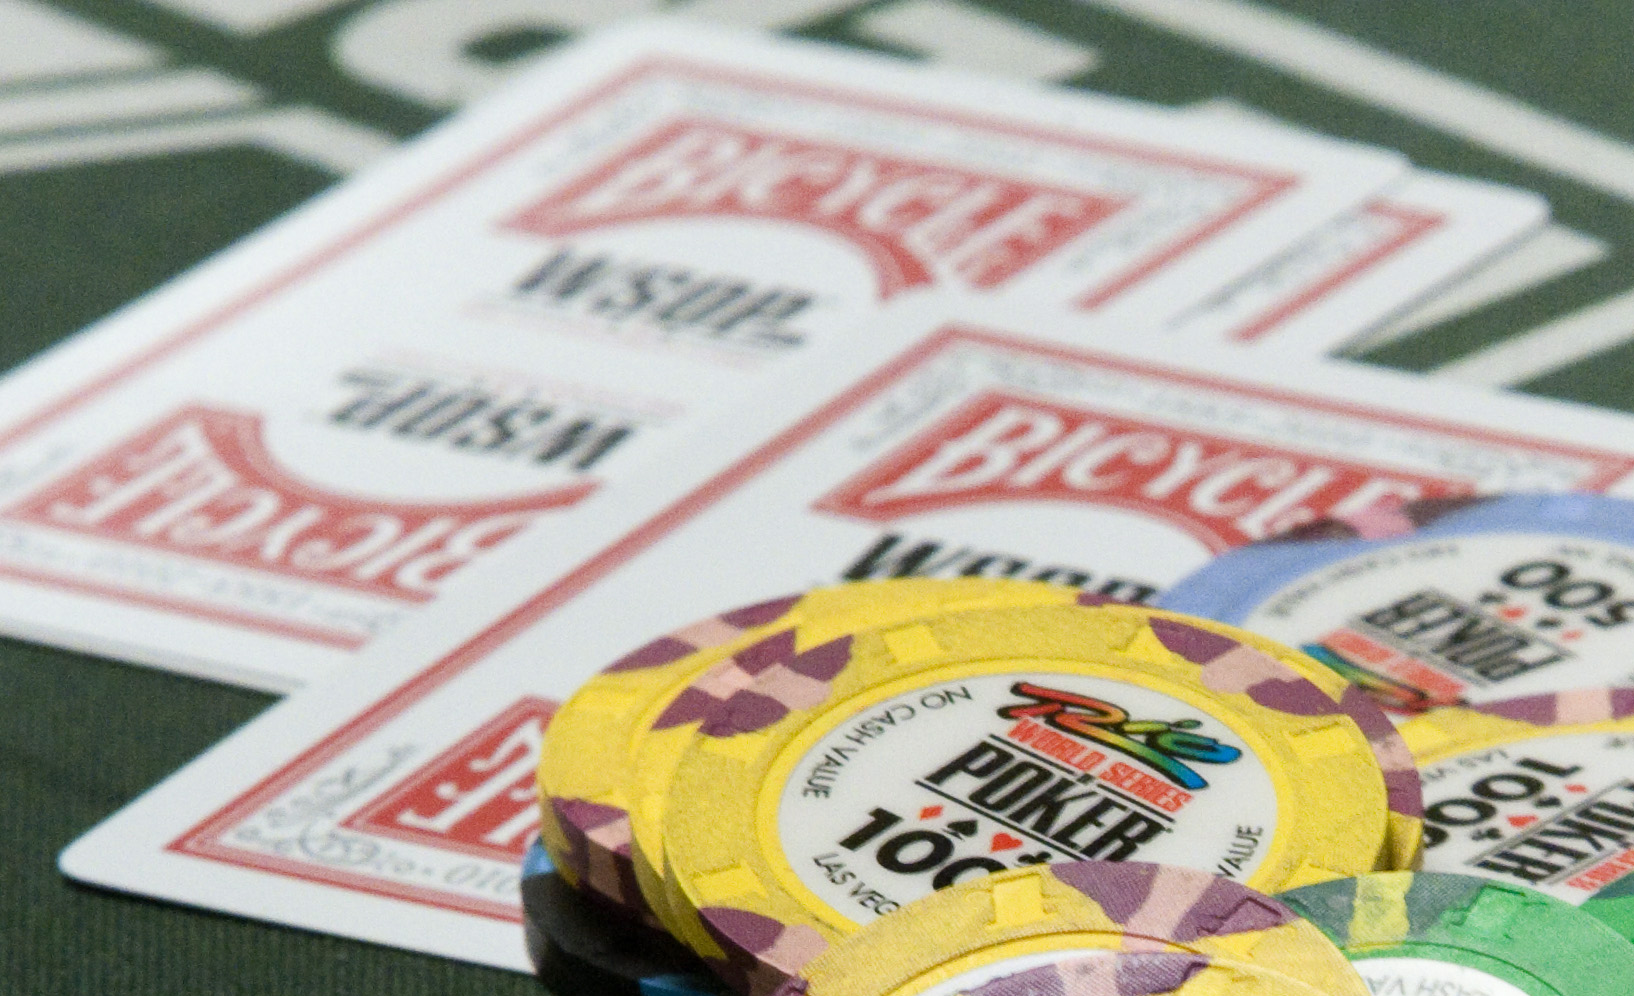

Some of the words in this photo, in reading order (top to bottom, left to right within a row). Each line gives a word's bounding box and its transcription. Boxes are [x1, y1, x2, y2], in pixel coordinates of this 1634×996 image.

[1360, 590, 1567, 684] POKER
[845, 702, 916, 747] CASH
[920, 686, 973, 710] NO
[802, 746, 858, 800] VALUE
[1007, 718, 1107, 773] WORLD
[1098, 761, 1194, 814] SERIES
[924, 740, 1168, 862] POKER
[1214, 823, 1265, 879] VALUE
[813, 852, 857, 886] LAS
[850, 881, 902, 916] VEG
